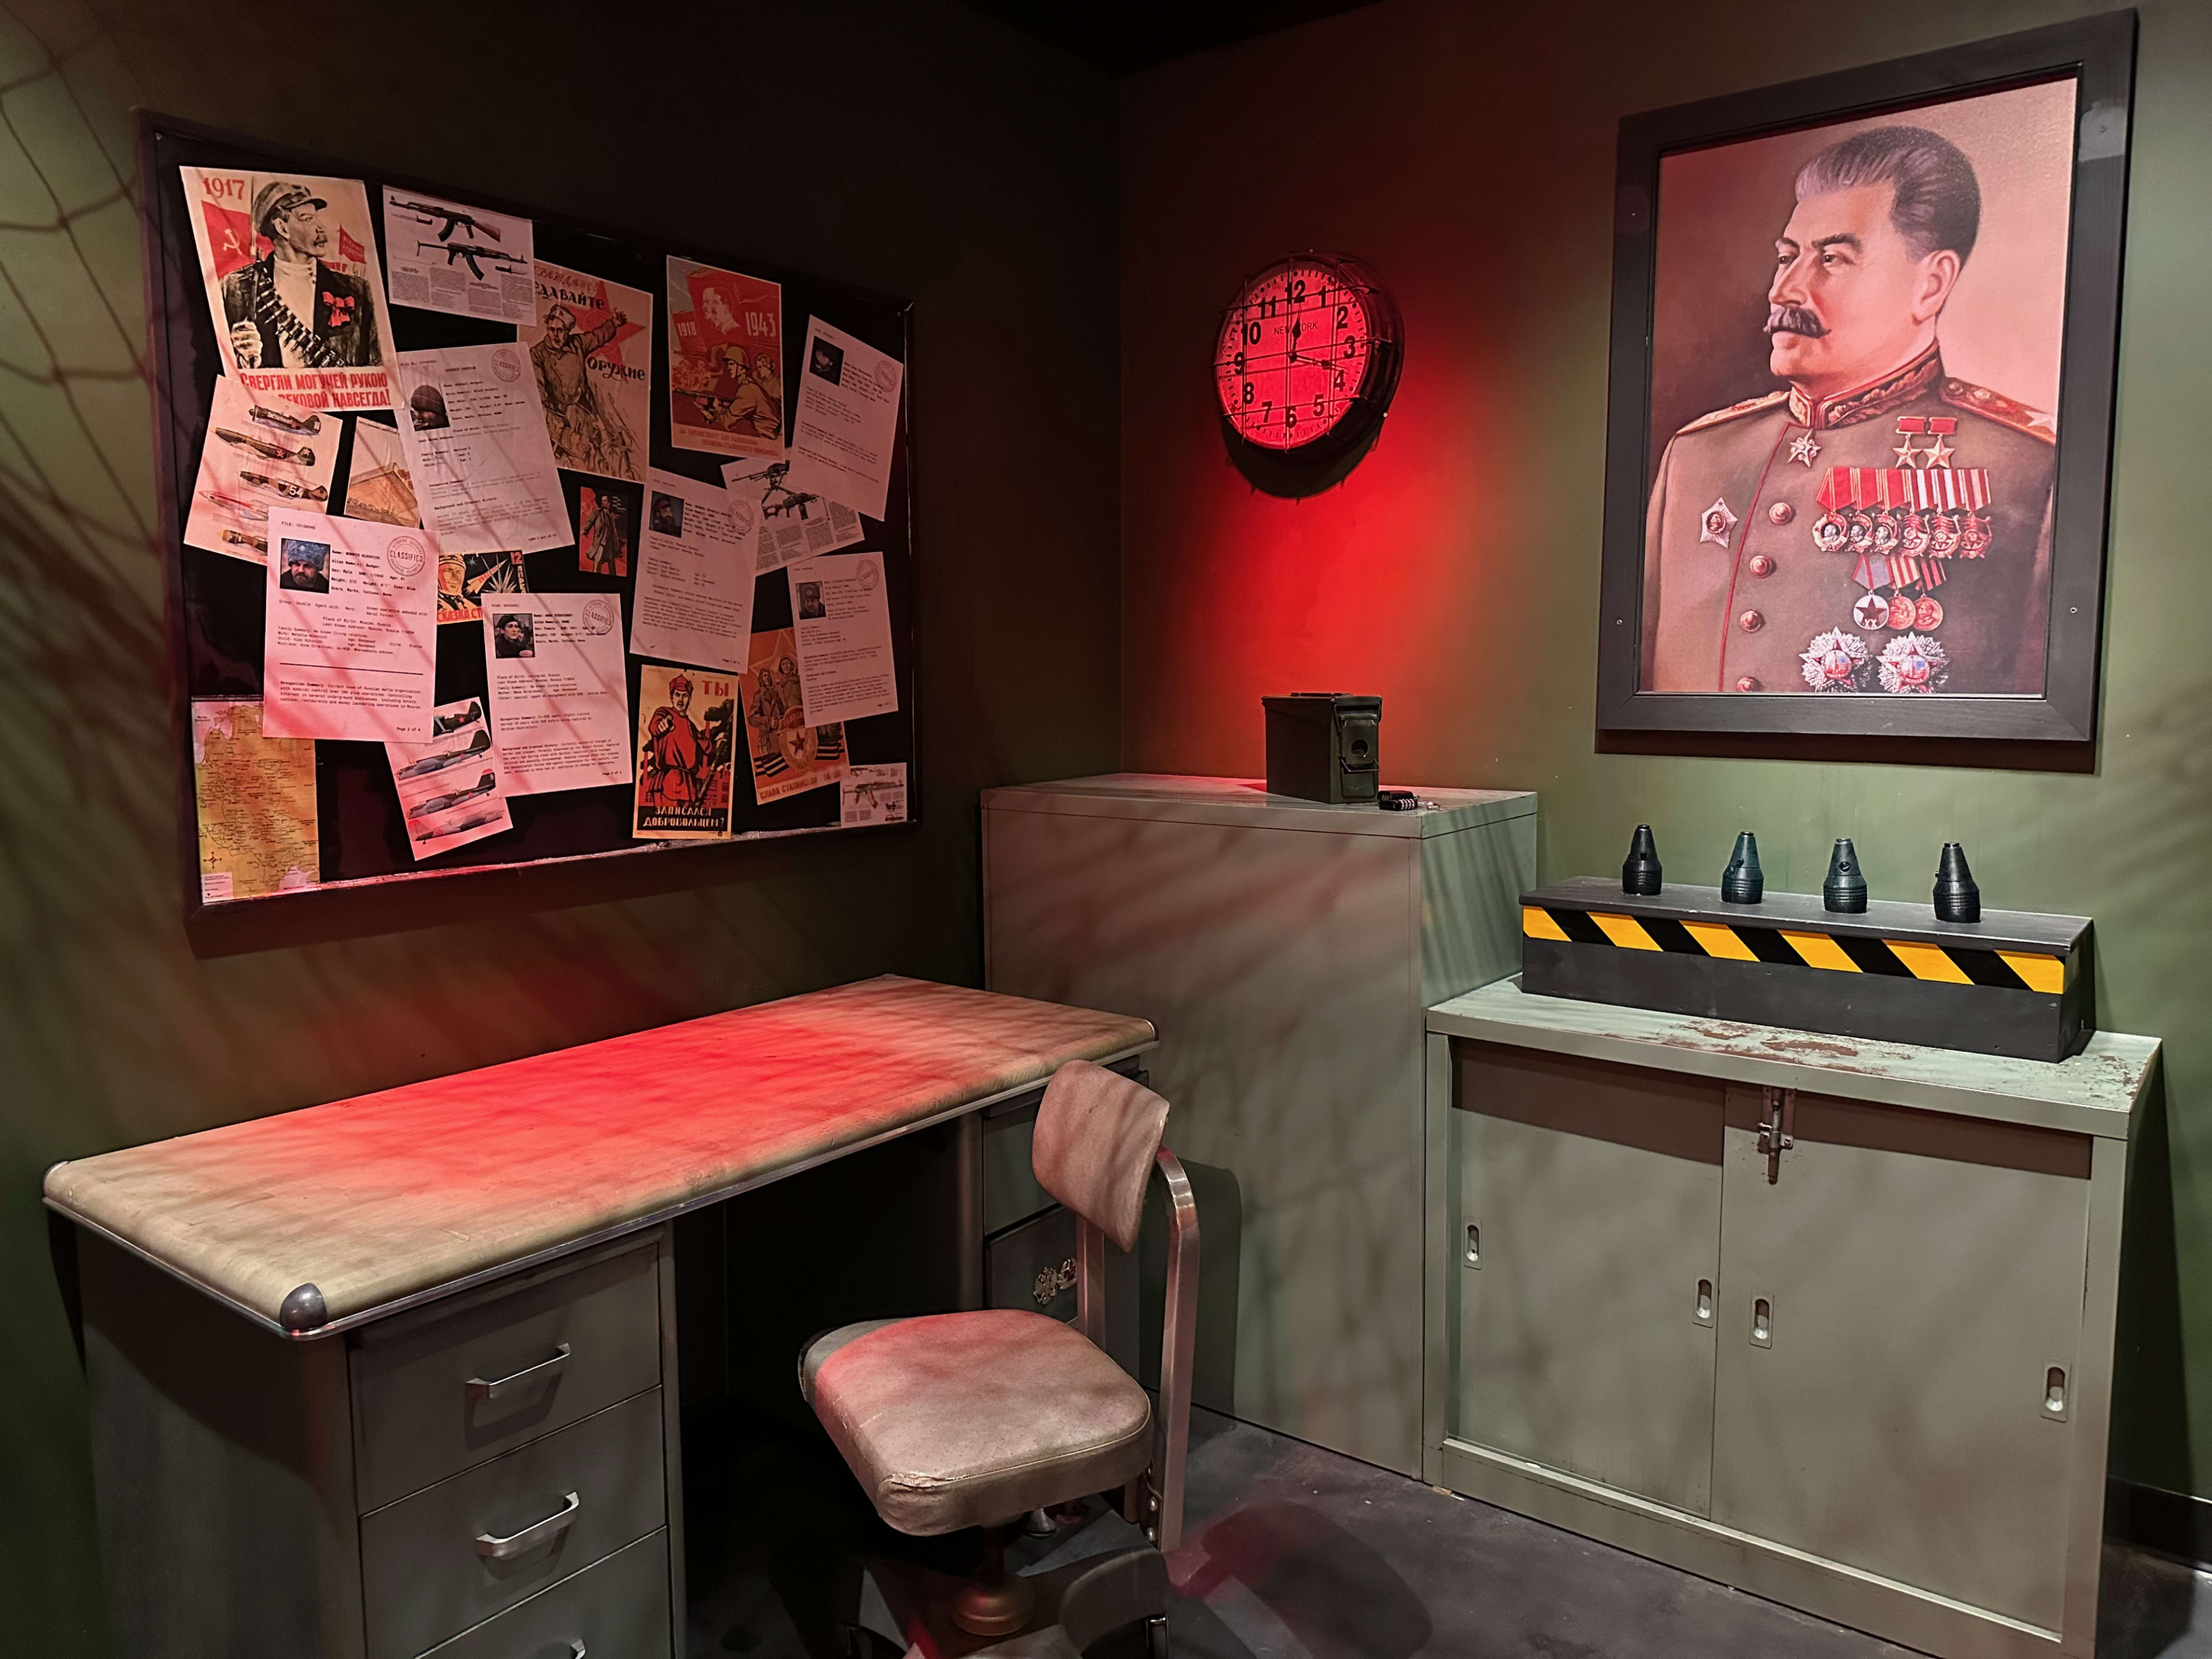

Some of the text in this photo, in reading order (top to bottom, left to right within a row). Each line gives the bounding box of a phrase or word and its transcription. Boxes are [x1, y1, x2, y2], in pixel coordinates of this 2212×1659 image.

[203, 178, 245, 200] 1917
[1285, 279, 1306, 304] 12
[1317, 285, 1327, 308] 1
[1258, 296, 1277, 319] 11
[1336, 305, 1349, 330] 2
[677, 321, 698, 337] 1918
[745, 311, 777, 338] 1943
[1241, 321, 1262, 346] 10
[1343, 335, 1356, 359] 3
[1233, 351, 1245, 375] 9
[294, 372, 347, 390] МОГУЧЕЙ
[350, 372, 388, 388] РУКОЮ
[1333, 369, 1346, 392] 4
[331, 389, 391, 407] НАВСЕГДА!
[1243, 381, 1255, 404] 8
[1262, 400, 1272, 423] 7
[1312, 393, 1325, 417] 5
[1285, 406, 1297, 429] 6
[289, 485, 304, 498] 54
[390, 550, 423, 563] CLASSIFIED
[510, 551, 522, 565] 12
[437, 609, 469, 623] СКАЗКА
[585, 609, 612, 626] CLASSIFIED
[702, 680, 729, 697] ТЫ
[760, 787, 781, 800] СЛАВА
[655, 806, 712, 816] ЗАПИСАЛСЯ
